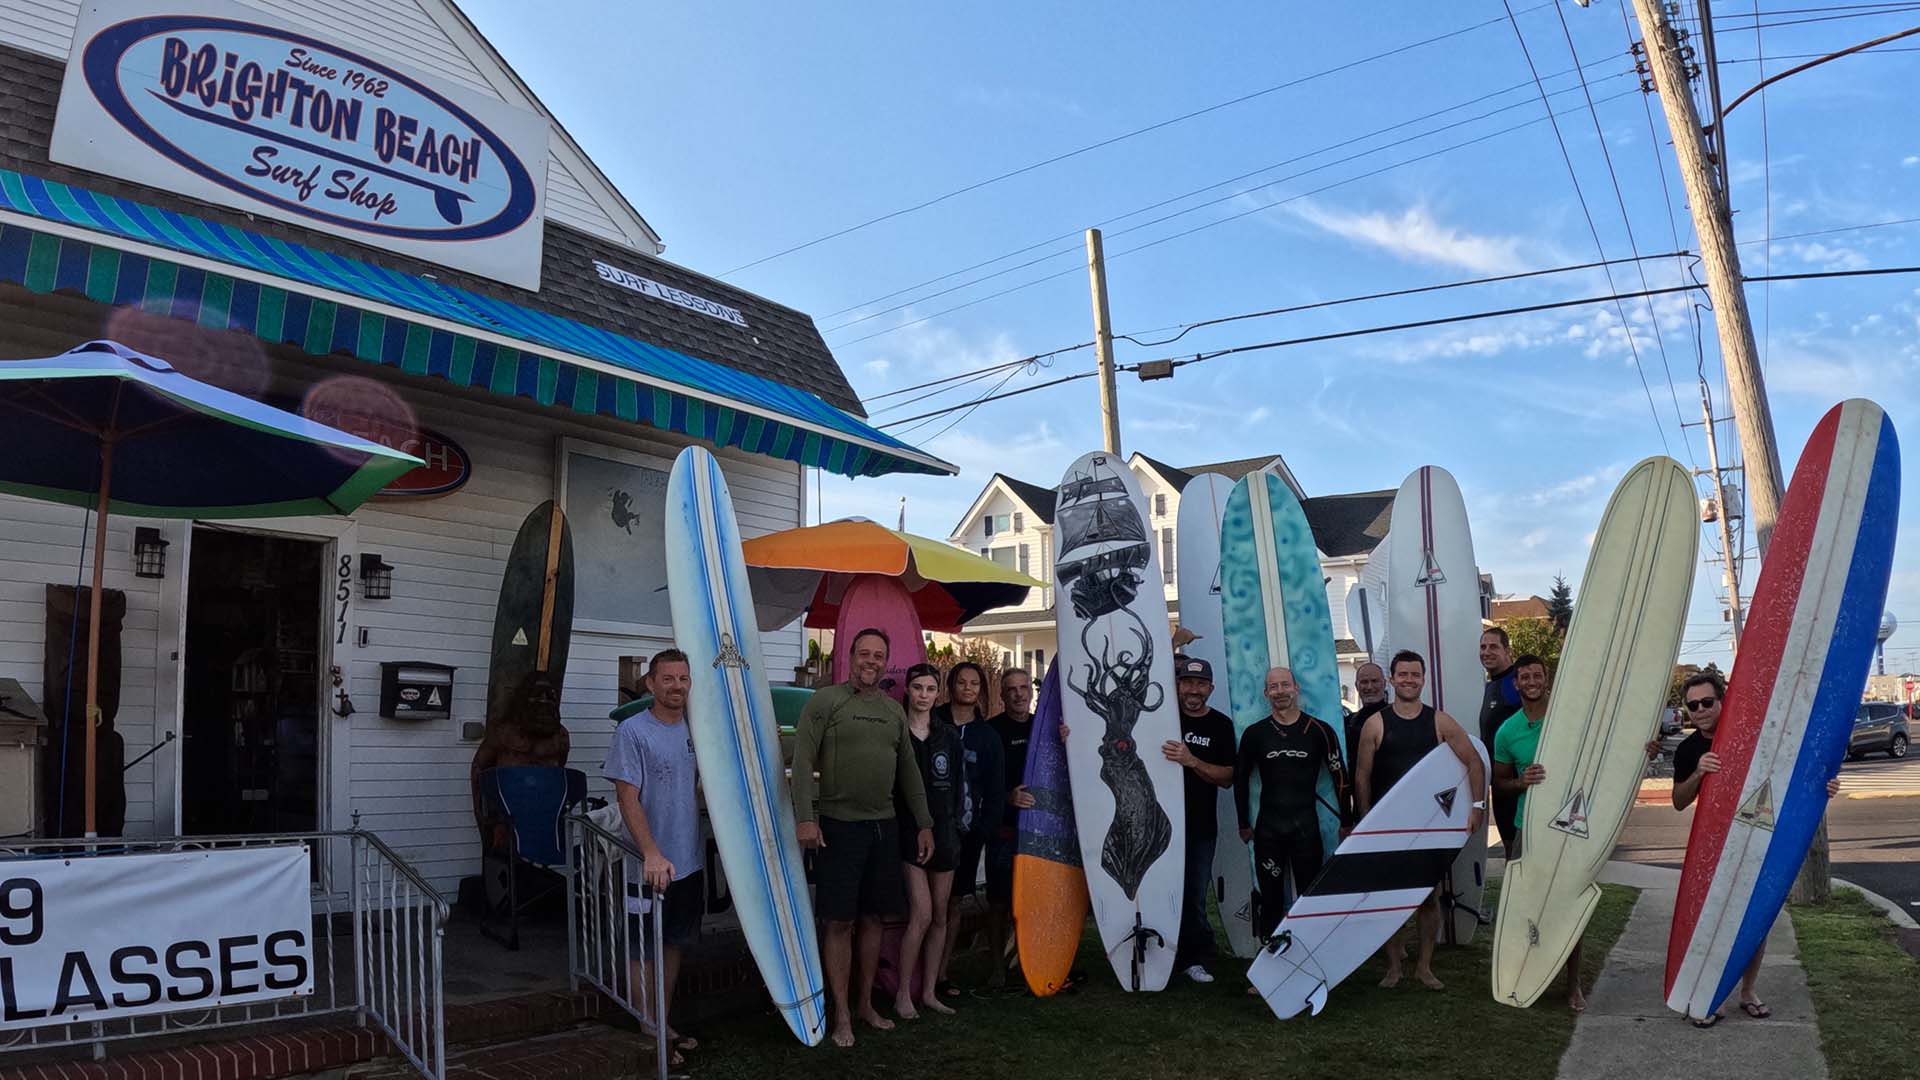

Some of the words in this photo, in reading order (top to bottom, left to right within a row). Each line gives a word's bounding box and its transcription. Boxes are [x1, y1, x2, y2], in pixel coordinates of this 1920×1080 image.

[285, 48, 337, 81] Since
[342, 68, 389, 98] 1962
[373, 107, 482, 185] BEACH
[244, 145, 324, 202] Surf
[324, 168, 398, 220] Shop
[595, 264, 651, 292] SURF
[654, 284, 746, 325] LESSONS
[336, 554, 352, 644] 8511
[1184, 732, 1211, 747] Coast
[1266, 749, 1308, 759] orca
